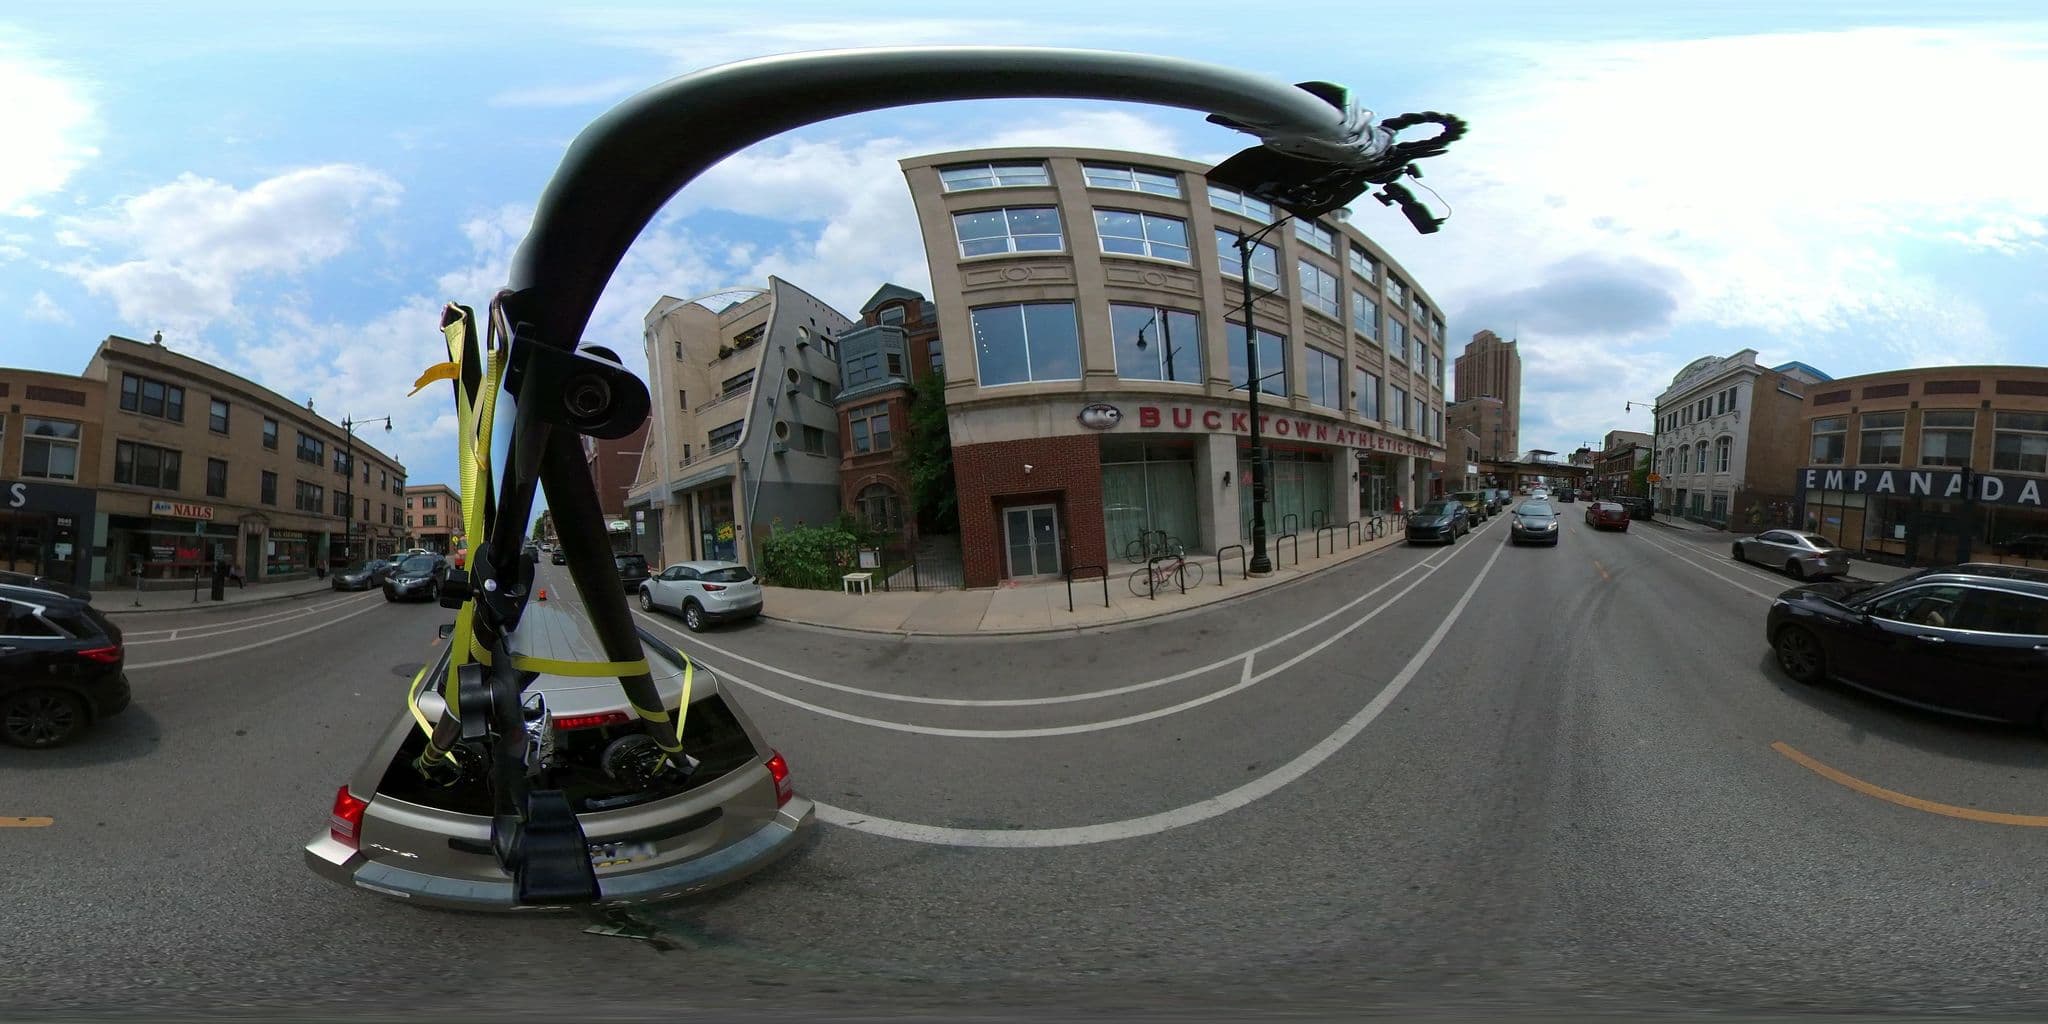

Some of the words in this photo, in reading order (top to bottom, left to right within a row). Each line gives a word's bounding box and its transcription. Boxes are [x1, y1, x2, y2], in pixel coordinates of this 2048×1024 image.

[1139, 406, 1328, 441] BUCKTOWN
[1336, 428, 1404, 453] ATHLETIC
[9, 482, 27, 508] S
[1805, 469, 2042, 506] EMPANADA
[174, 503, 212, 518] NAILS
